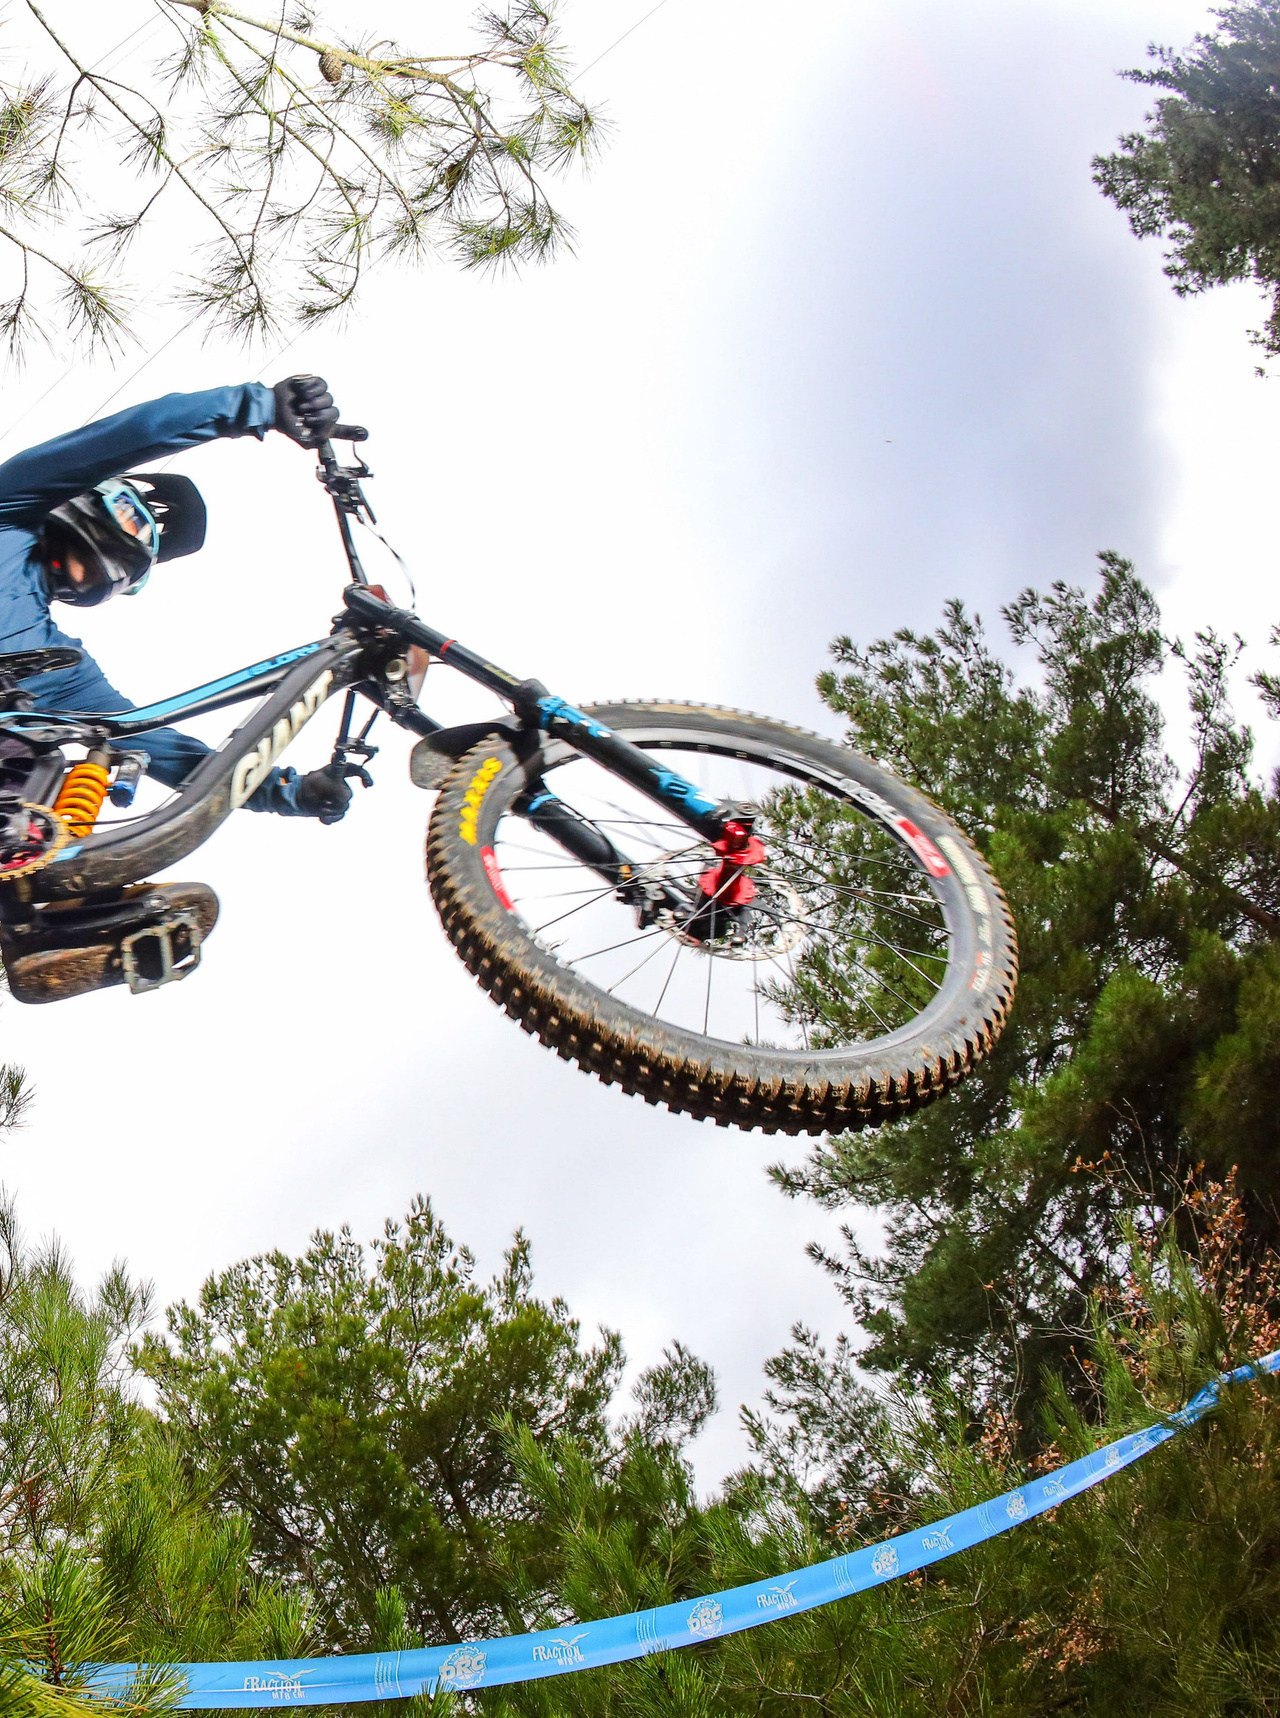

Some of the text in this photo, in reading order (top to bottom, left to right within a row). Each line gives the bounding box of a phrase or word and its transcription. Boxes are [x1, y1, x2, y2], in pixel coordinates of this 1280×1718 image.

[872, 1548, 898, 1576] DRC
[756, 1592, 795, 1608] FRACTION
[687, 1604, 723, 1634] DRC
[532, 1646, 581, 1661] FRACTION
[439, 1653, 487, 1682] DRC
[243, 1676, 302, 1693] FRACTION
[272, 1691, 291, 1700] MTB
